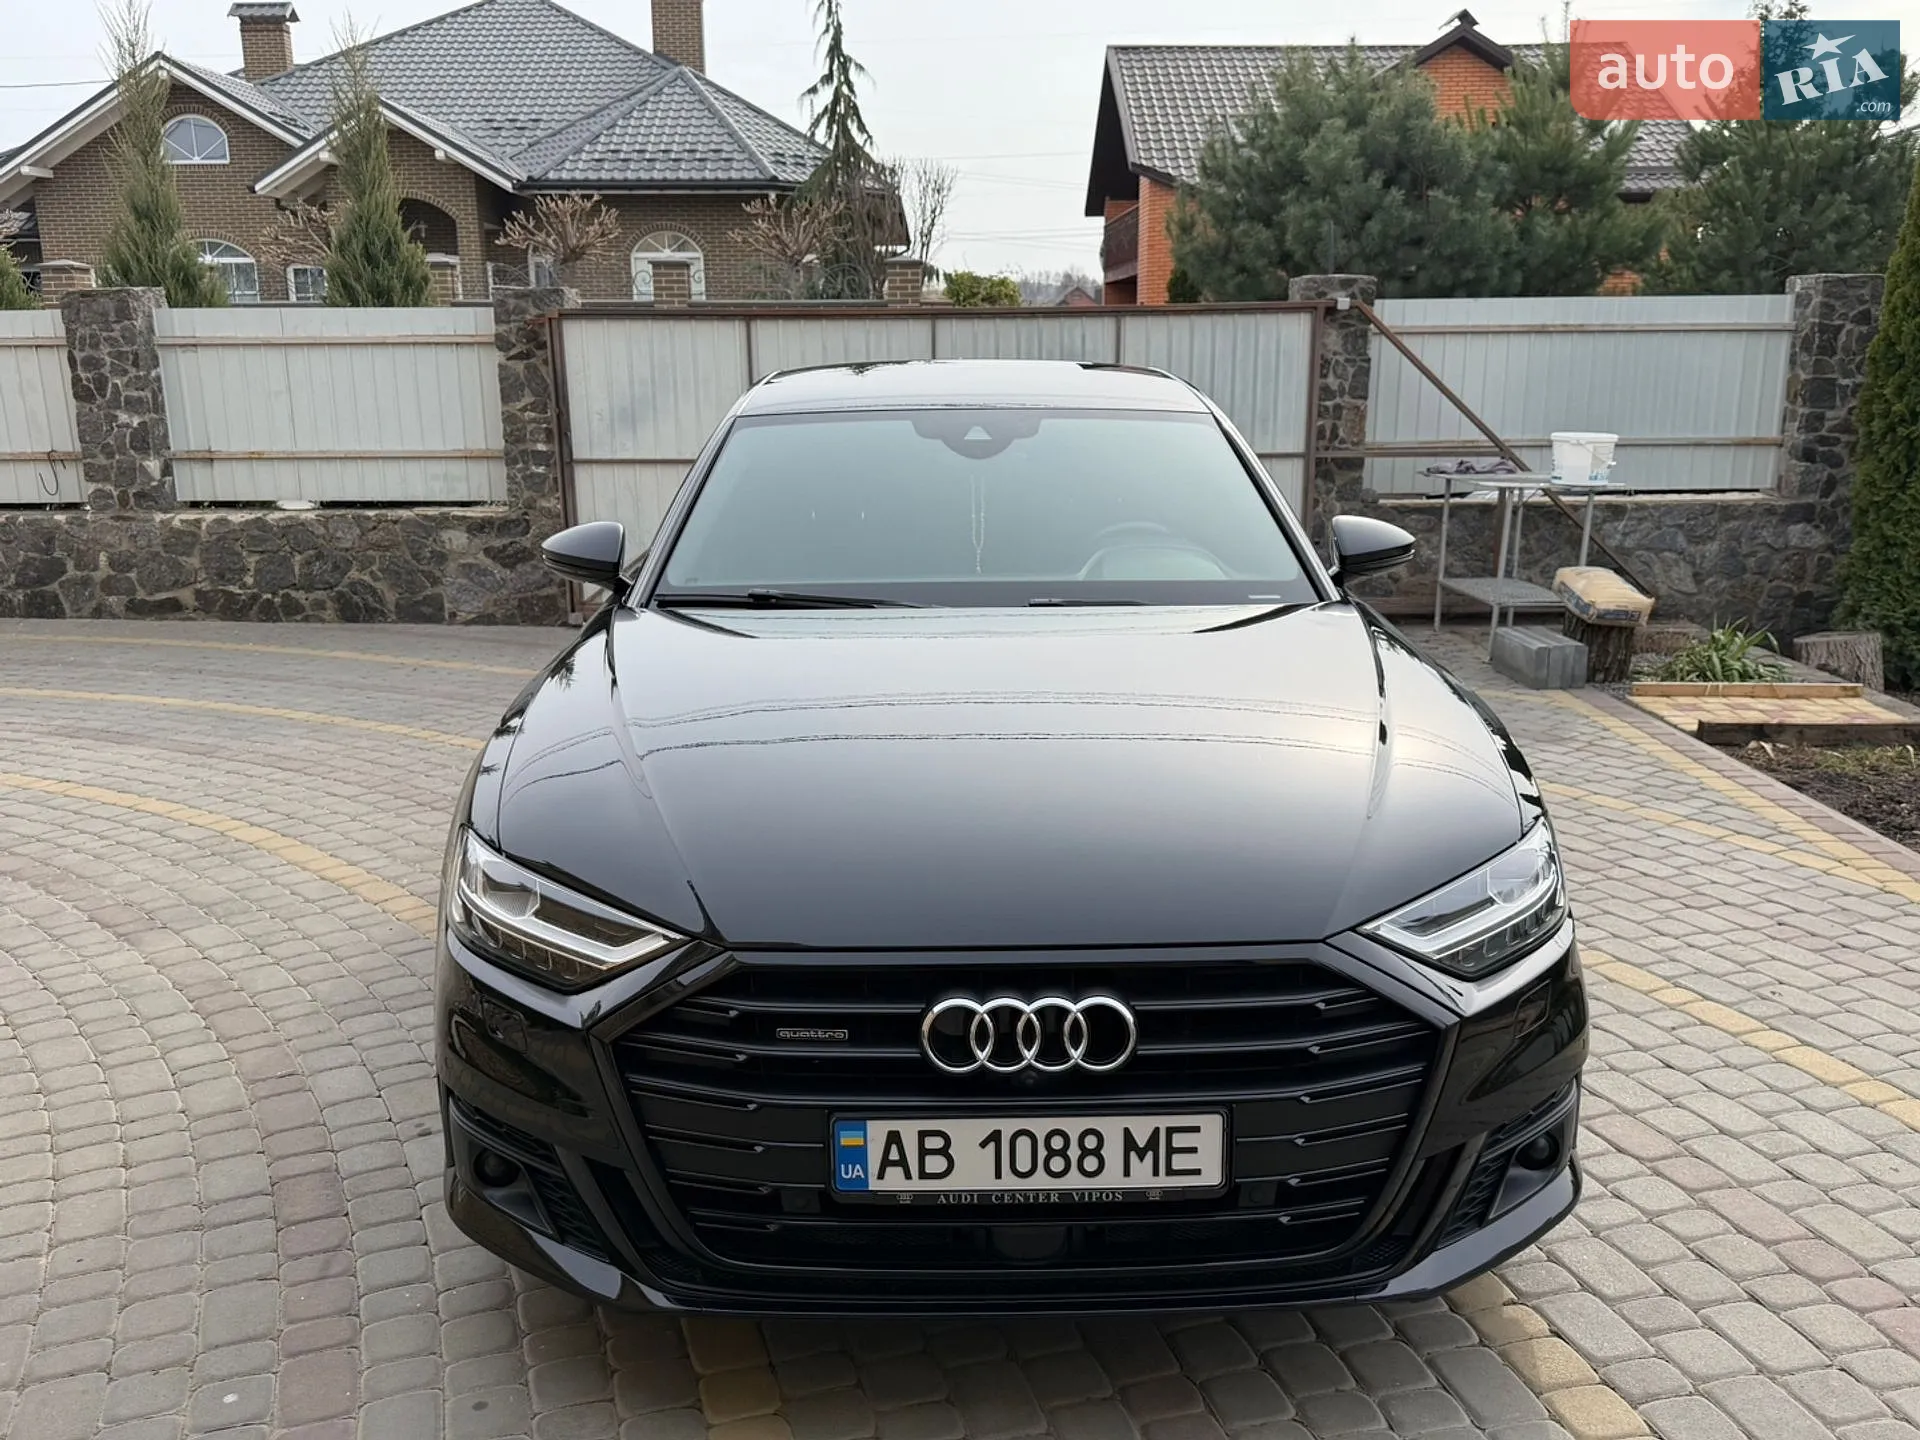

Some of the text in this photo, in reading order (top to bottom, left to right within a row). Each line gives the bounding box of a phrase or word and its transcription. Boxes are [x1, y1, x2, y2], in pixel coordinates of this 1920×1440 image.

[779, 1030, 845, 1039] quattro
[876, 1125, 1203, 1181] AB 1088 ME
[840, 1163, 865, 1179] UA
[936, 1190, 1124, 1205] AUDI CENTER VIPOS
